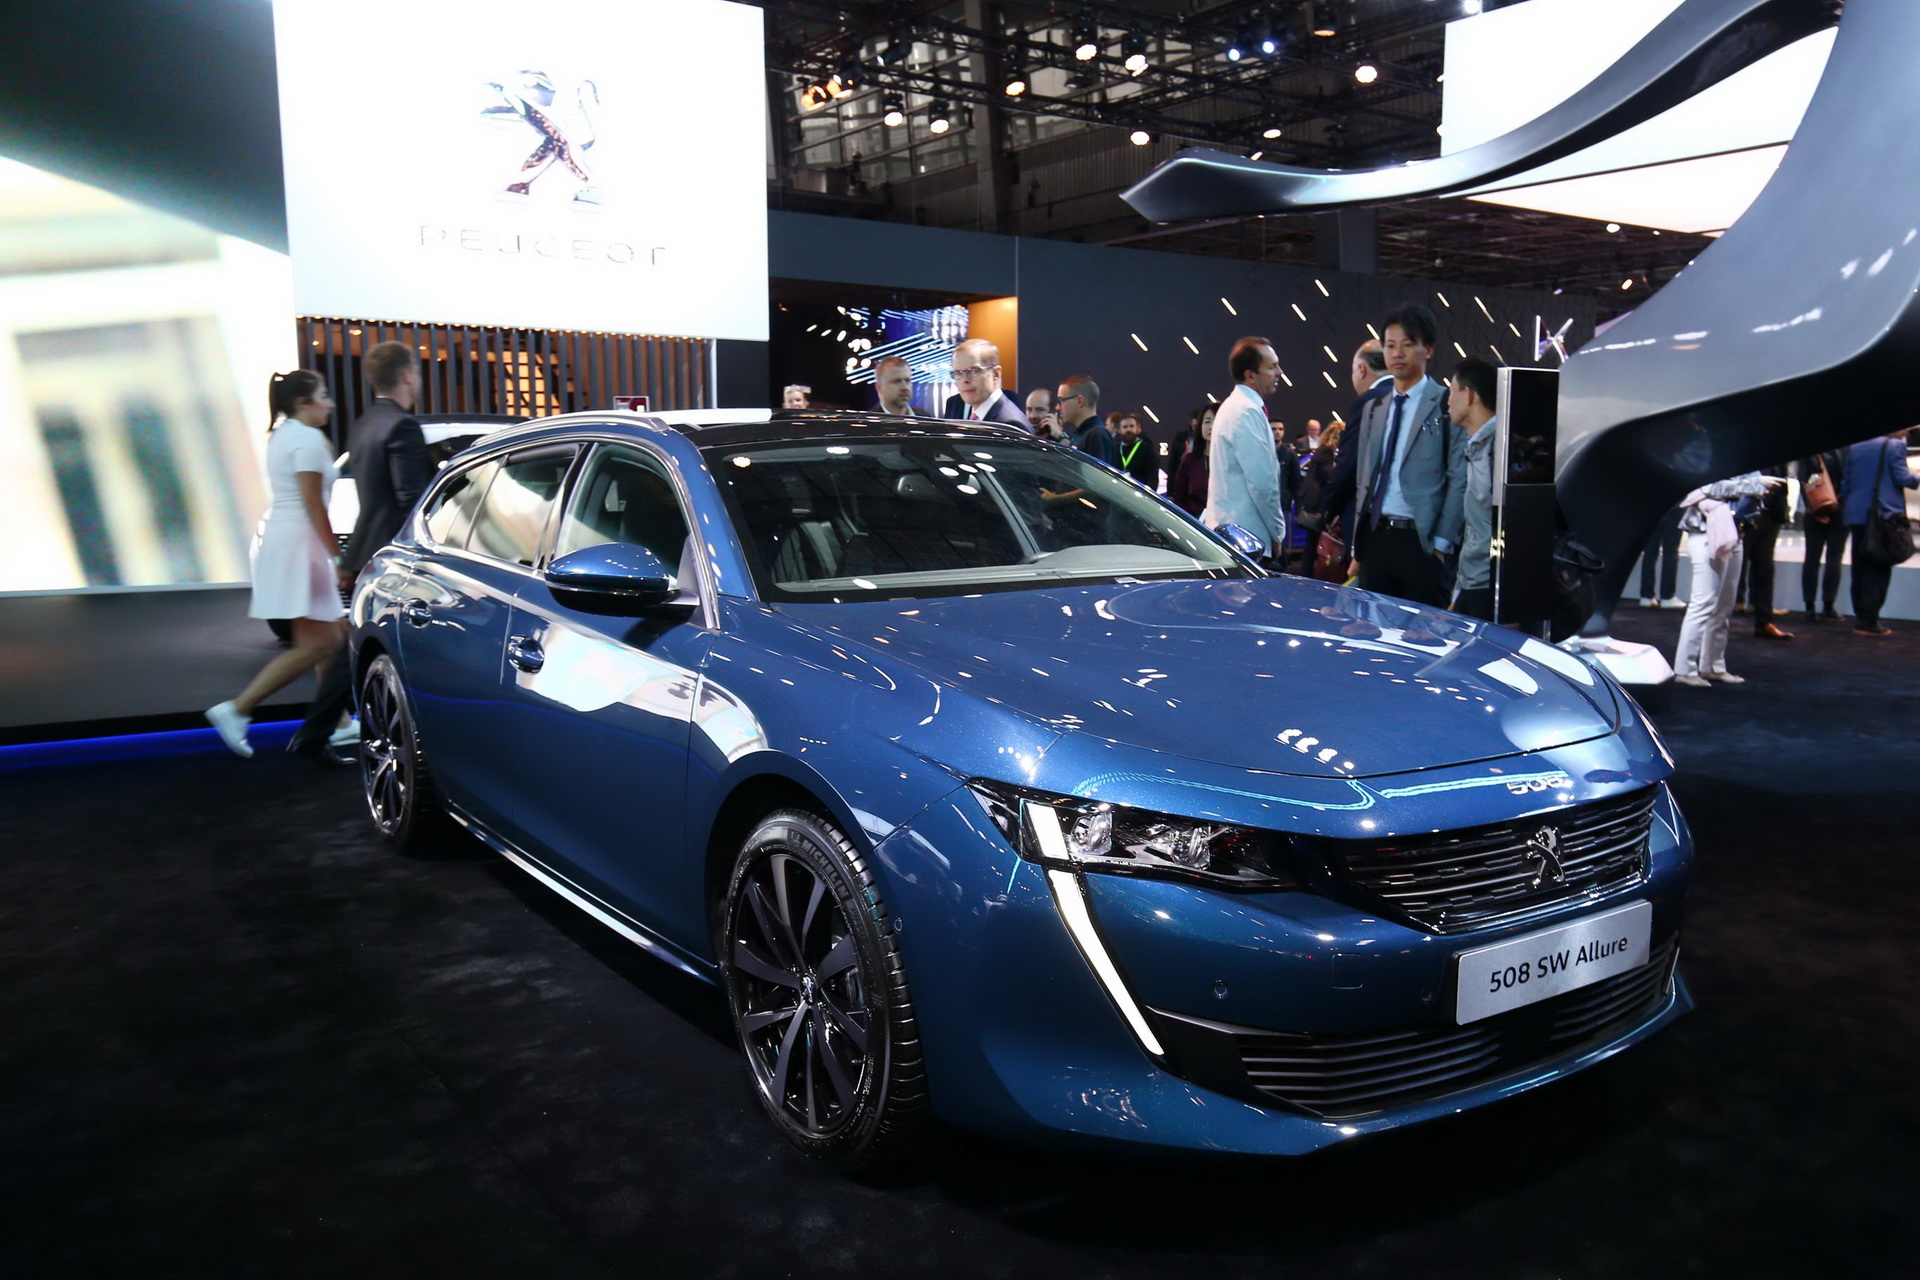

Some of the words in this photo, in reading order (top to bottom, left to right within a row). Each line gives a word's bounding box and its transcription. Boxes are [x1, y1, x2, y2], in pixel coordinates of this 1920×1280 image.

[1506, 776, 1566, 795] 508
[801, 839, 852, 898] MICHELIN
[1489, 961, 1531, 993] 508
[1536, 949, 1570, 979] SW
[1575, 936, 1628, 966] Allure
